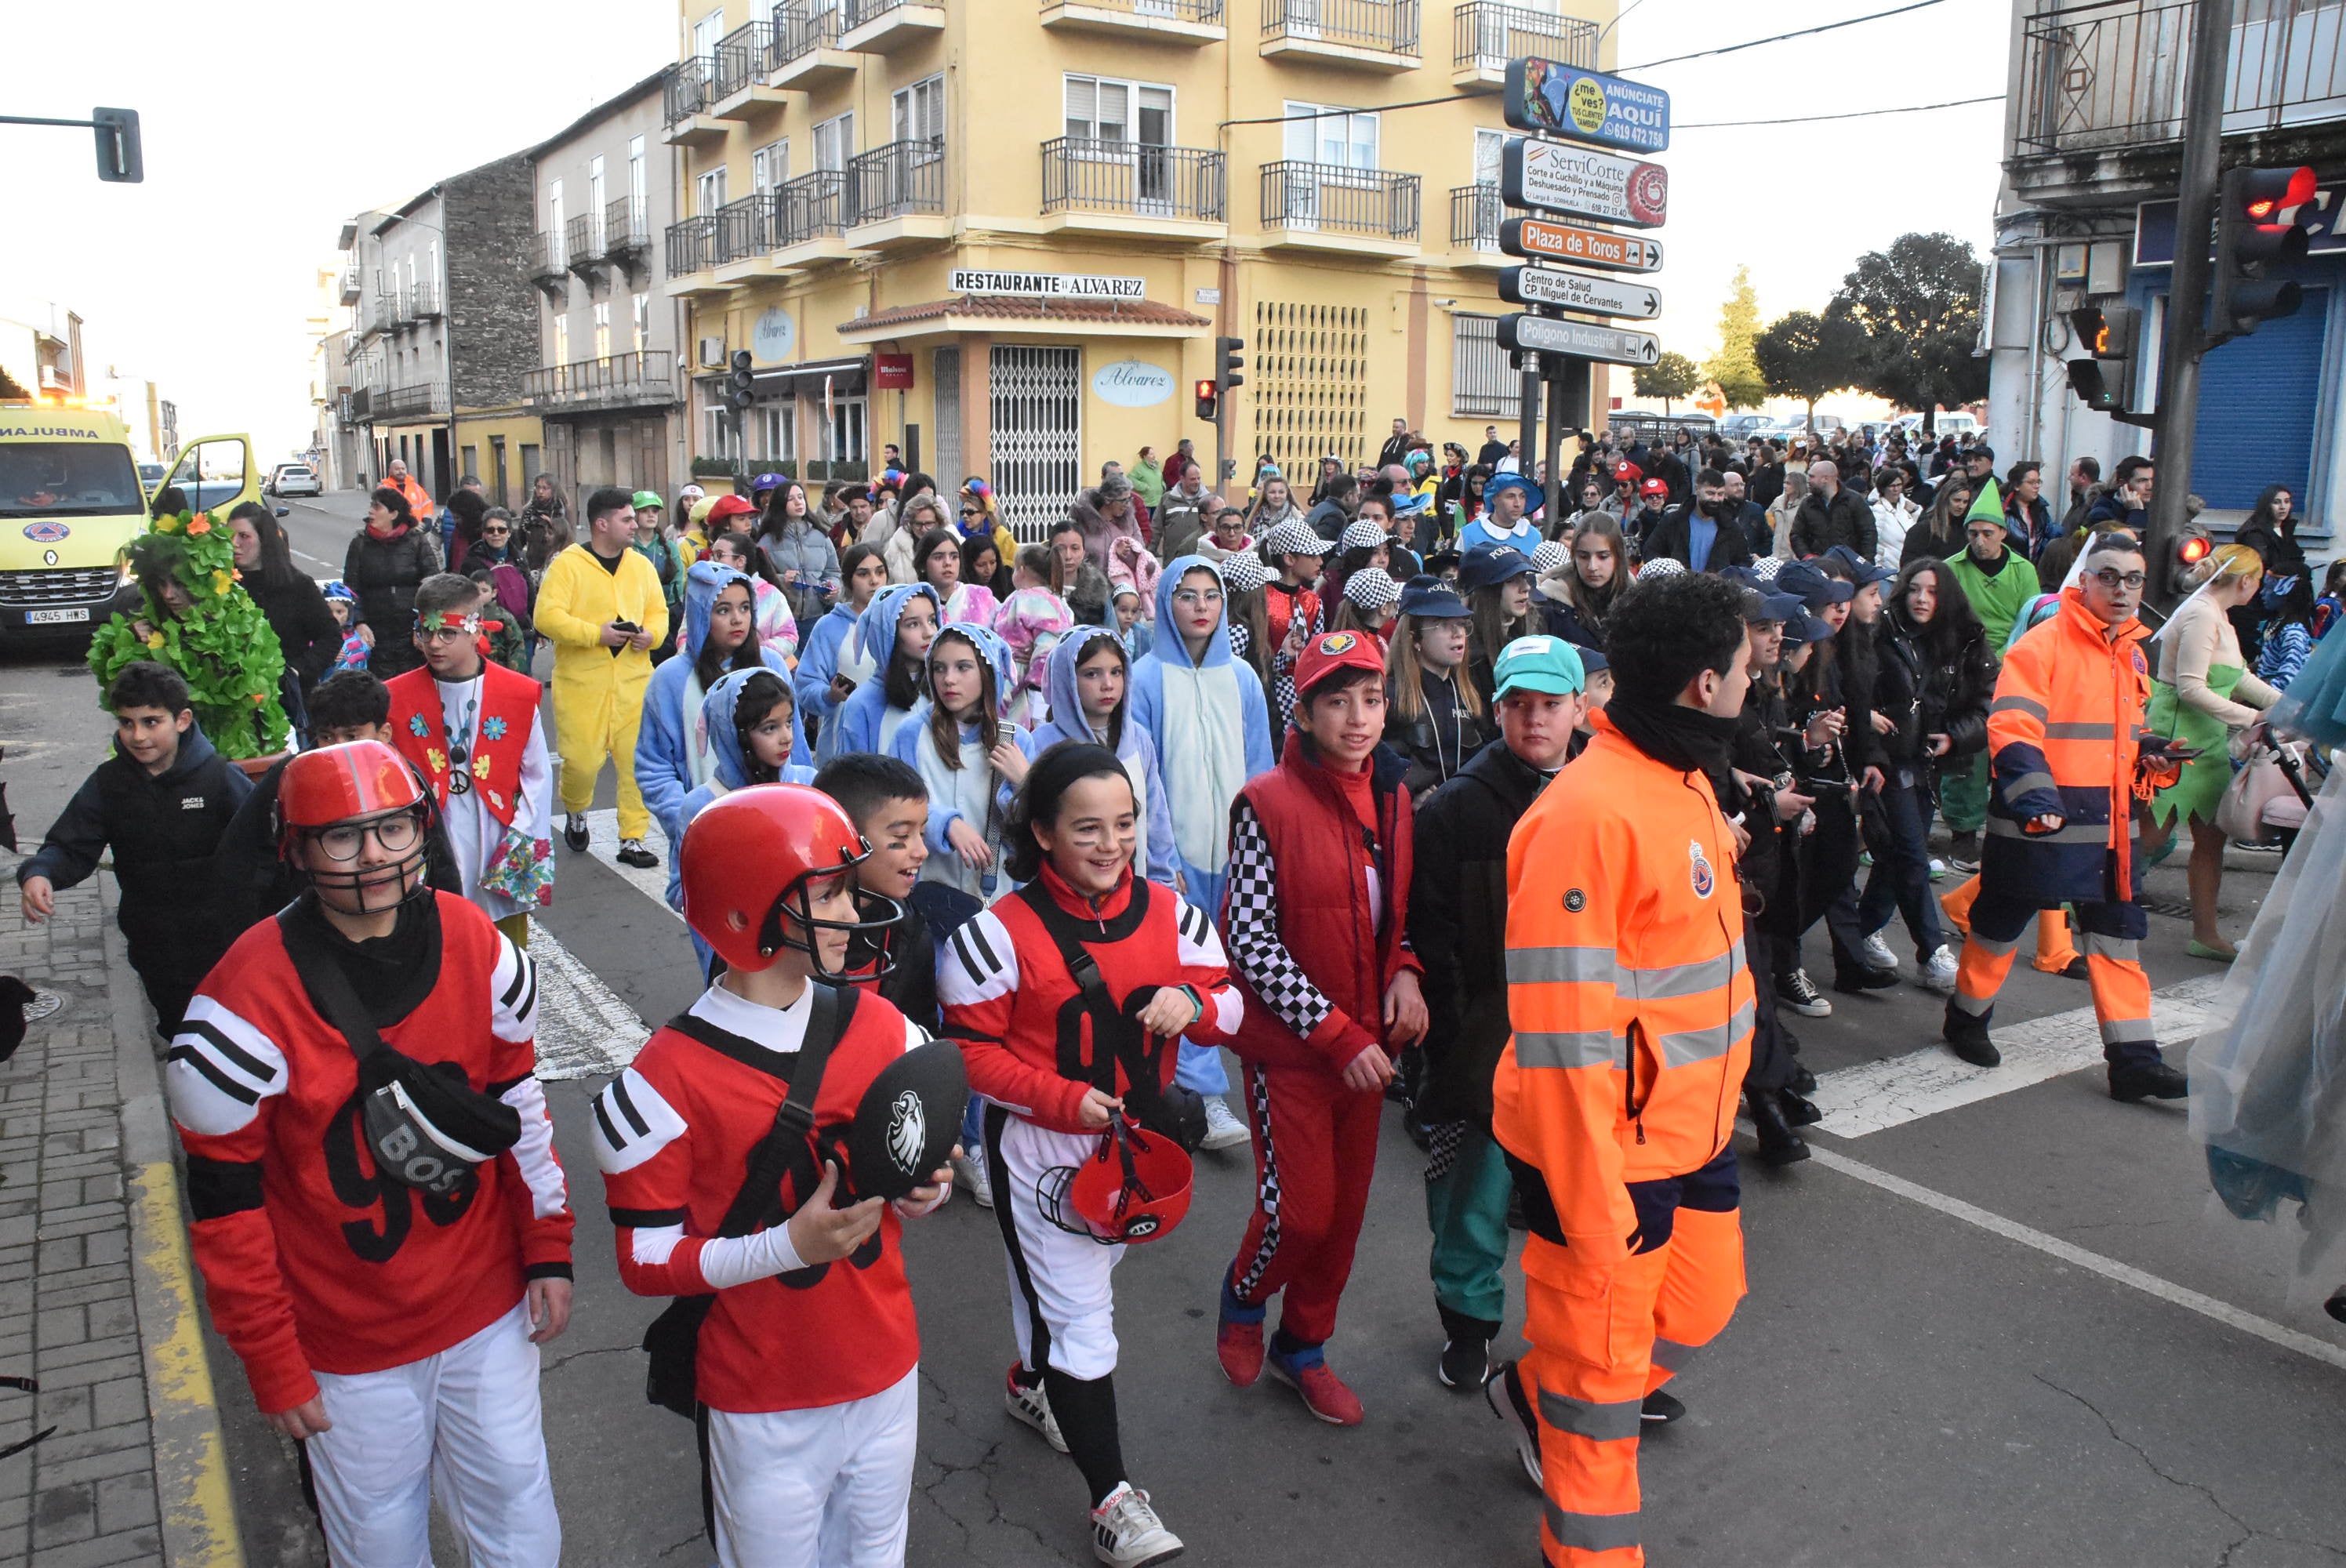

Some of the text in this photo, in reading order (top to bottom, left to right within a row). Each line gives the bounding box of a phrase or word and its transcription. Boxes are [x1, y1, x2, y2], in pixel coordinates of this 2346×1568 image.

[1574, 84, 1595, 96] ¿me
[1606, 84, 1664, 108] ANÚNCIATE
[1572, 107, 1603, 121] TUS CLIENTES
[1582, 96, 1603, 110] ves?
[1607, 102, 1662, 128] AQUÍ
[1615, 123, 1663, 147] 619 472 758
[1550, 149, 1624, 182] ServiCorte
[1527, 165, 1548, 177] Corte
[1556, 171, 1582, 185] Cuchillo
[1596, 180, 1623, 194] Máquina
[1529, 177, 1571, 193] Deshuesado
[1578, 187, 1610, 201] Prensado
[1592, 203, 1602, 213] 618
[1603, 205, 1611, 215] 27
[1611, 207, 1618, 216] 13
[1618, 209, 1627, 218] 40
[1527, 226, 1620, 260] Plaza de Toros
[956, 272, 1143, 297] RESTAURANTE ALVAREZ
[1525, 271, 1592, 292] Centro de Salud
[1524, 283, 1623, 310] CP. Miguel de Cervantes
[1572, 328, 1618, 350] Industrial
[1100, 366, 1166, 387] Alvarez
[34, 612, 61, 622] 4945
